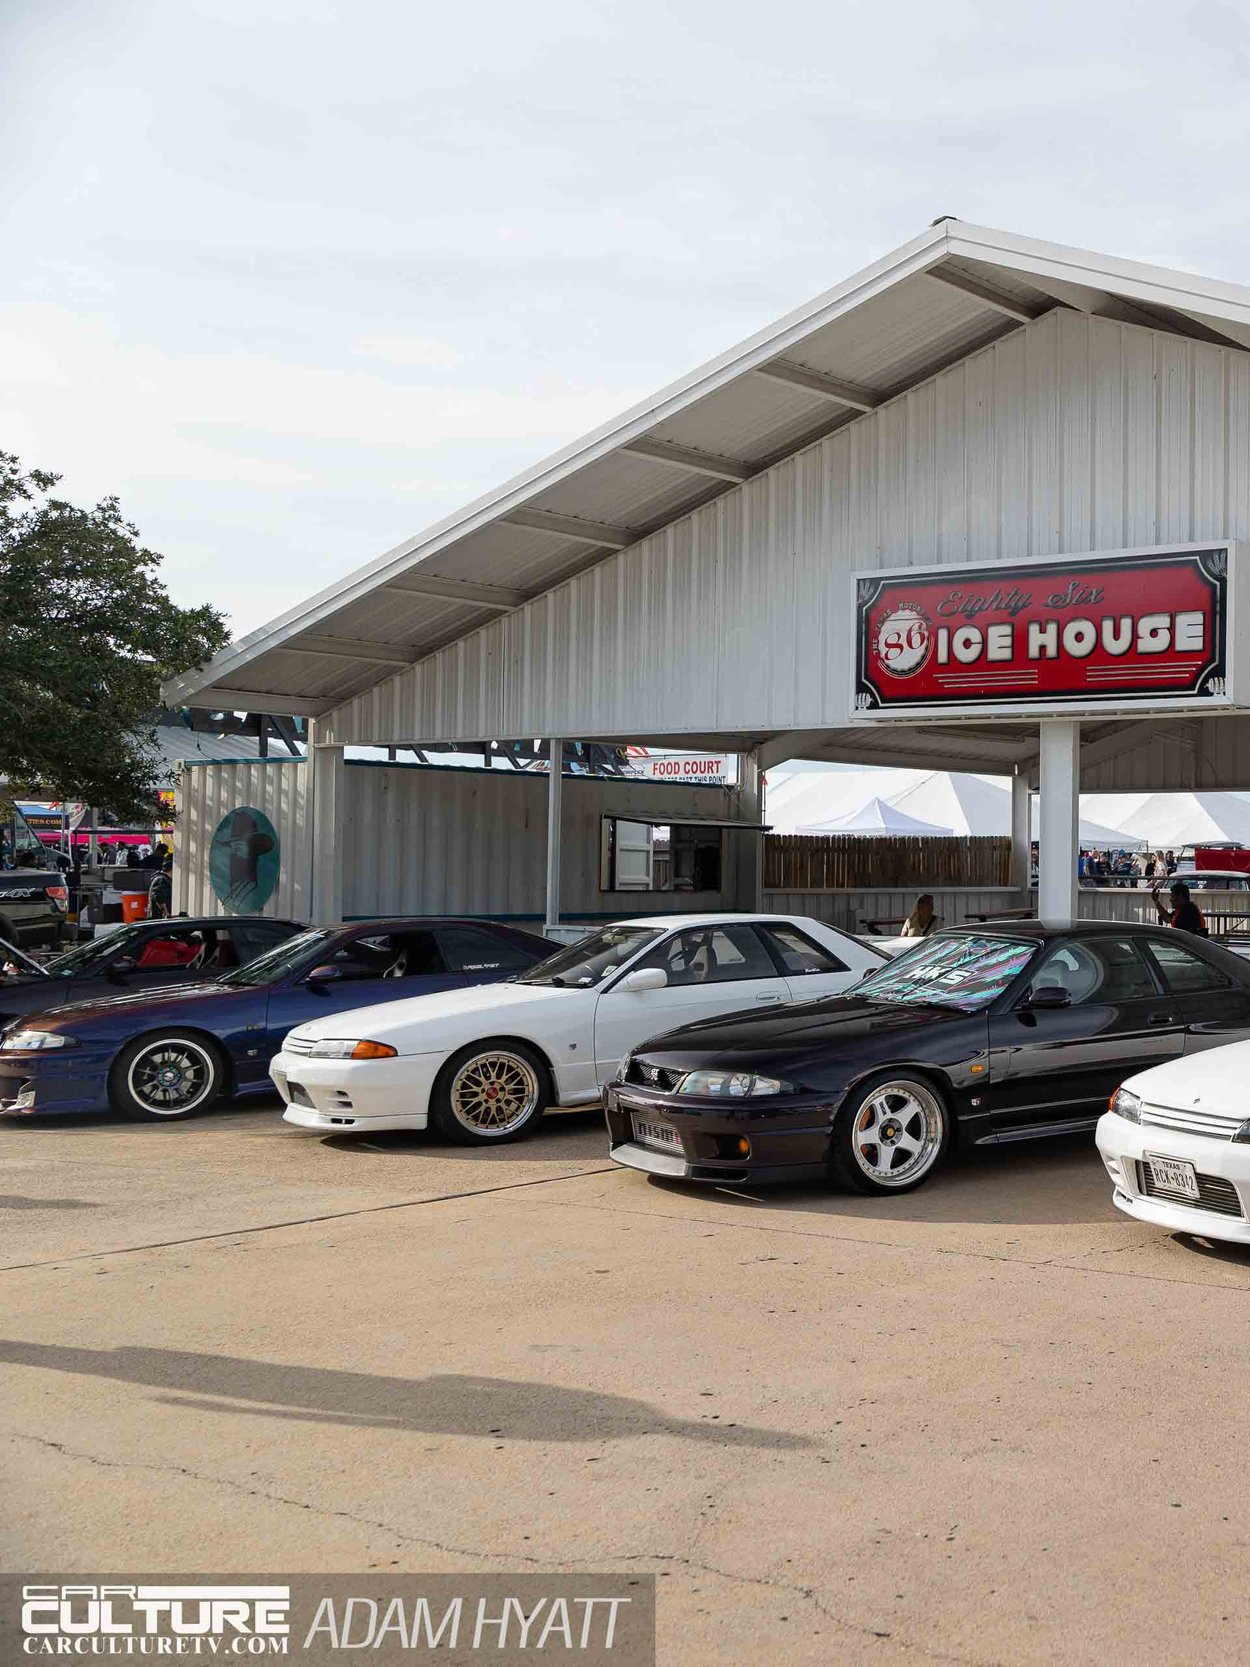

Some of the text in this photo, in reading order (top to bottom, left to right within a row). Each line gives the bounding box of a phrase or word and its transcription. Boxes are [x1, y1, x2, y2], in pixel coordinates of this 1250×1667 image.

[936, 579, 1104, 621] Eighty Six
[884, 621, 928, 662] 86
[936, 610, 1205, 666] ICE HOUSE
[652, 761, 680, 776] FOOD
[683, 760, 722, 775] COURT
[904, 965, 972, 985] HKS
[1162, 1161, 1181, 1170] TEXAS
